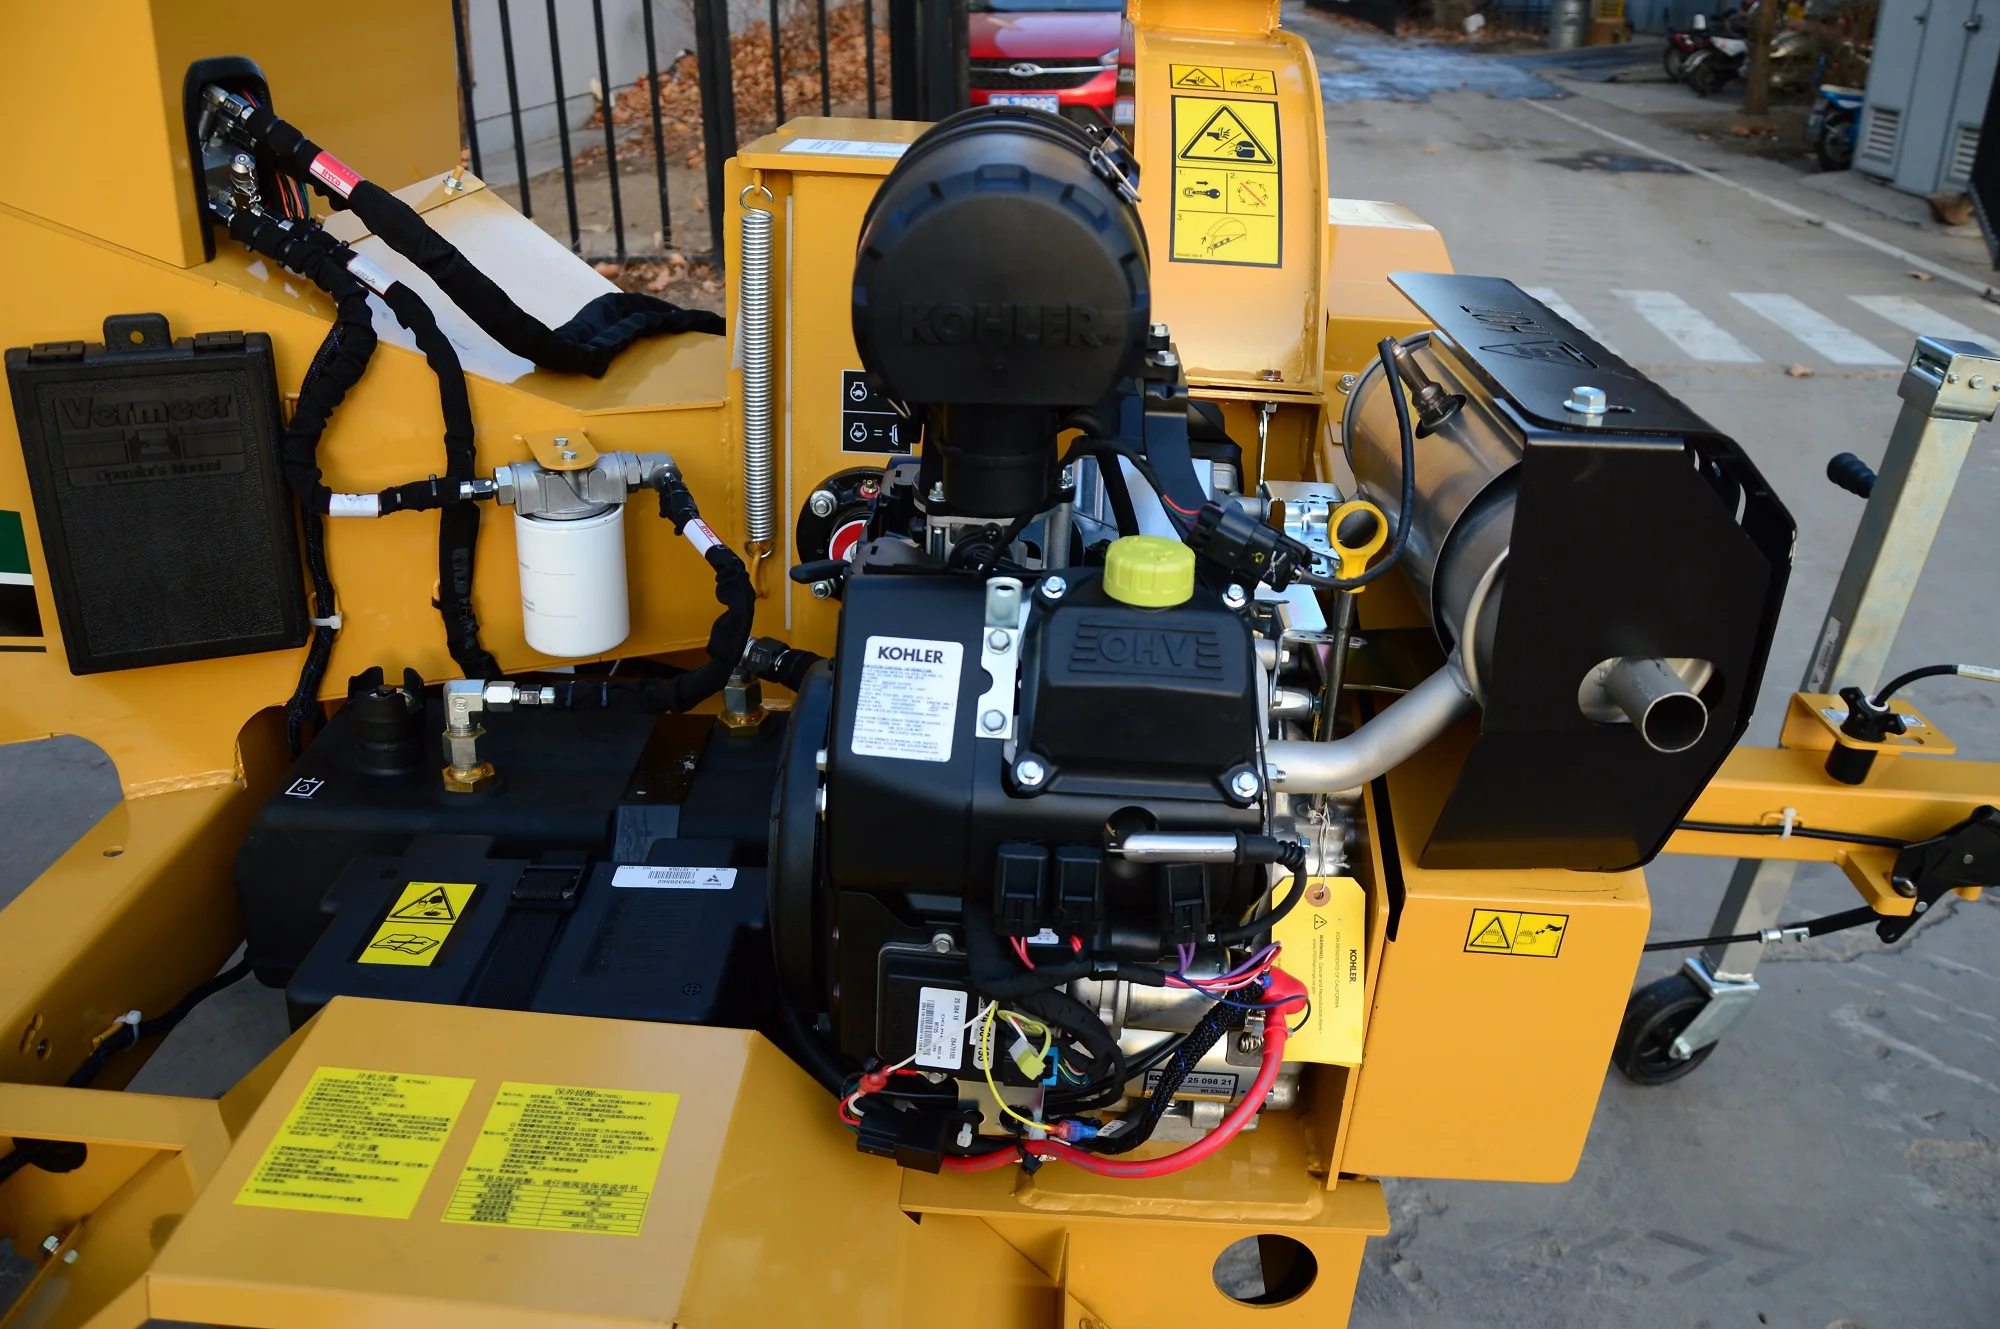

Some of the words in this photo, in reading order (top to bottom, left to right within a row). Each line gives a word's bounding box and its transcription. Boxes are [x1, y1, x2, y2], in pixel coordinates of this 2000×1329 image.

[902, 303, 1102, 347] KOHLER
[58, 394, 232, 430] Vermeer
[96, 464, 167, 484] Operator's
[172, 459, 221, 475] Manual
[877, 645, 944, 664] KOHLER
[1101, 630, 1186, 667] OHV
[1349, 949, 1357, 983] KOHLER
[1201, 1077, 1218, 1085] 098
